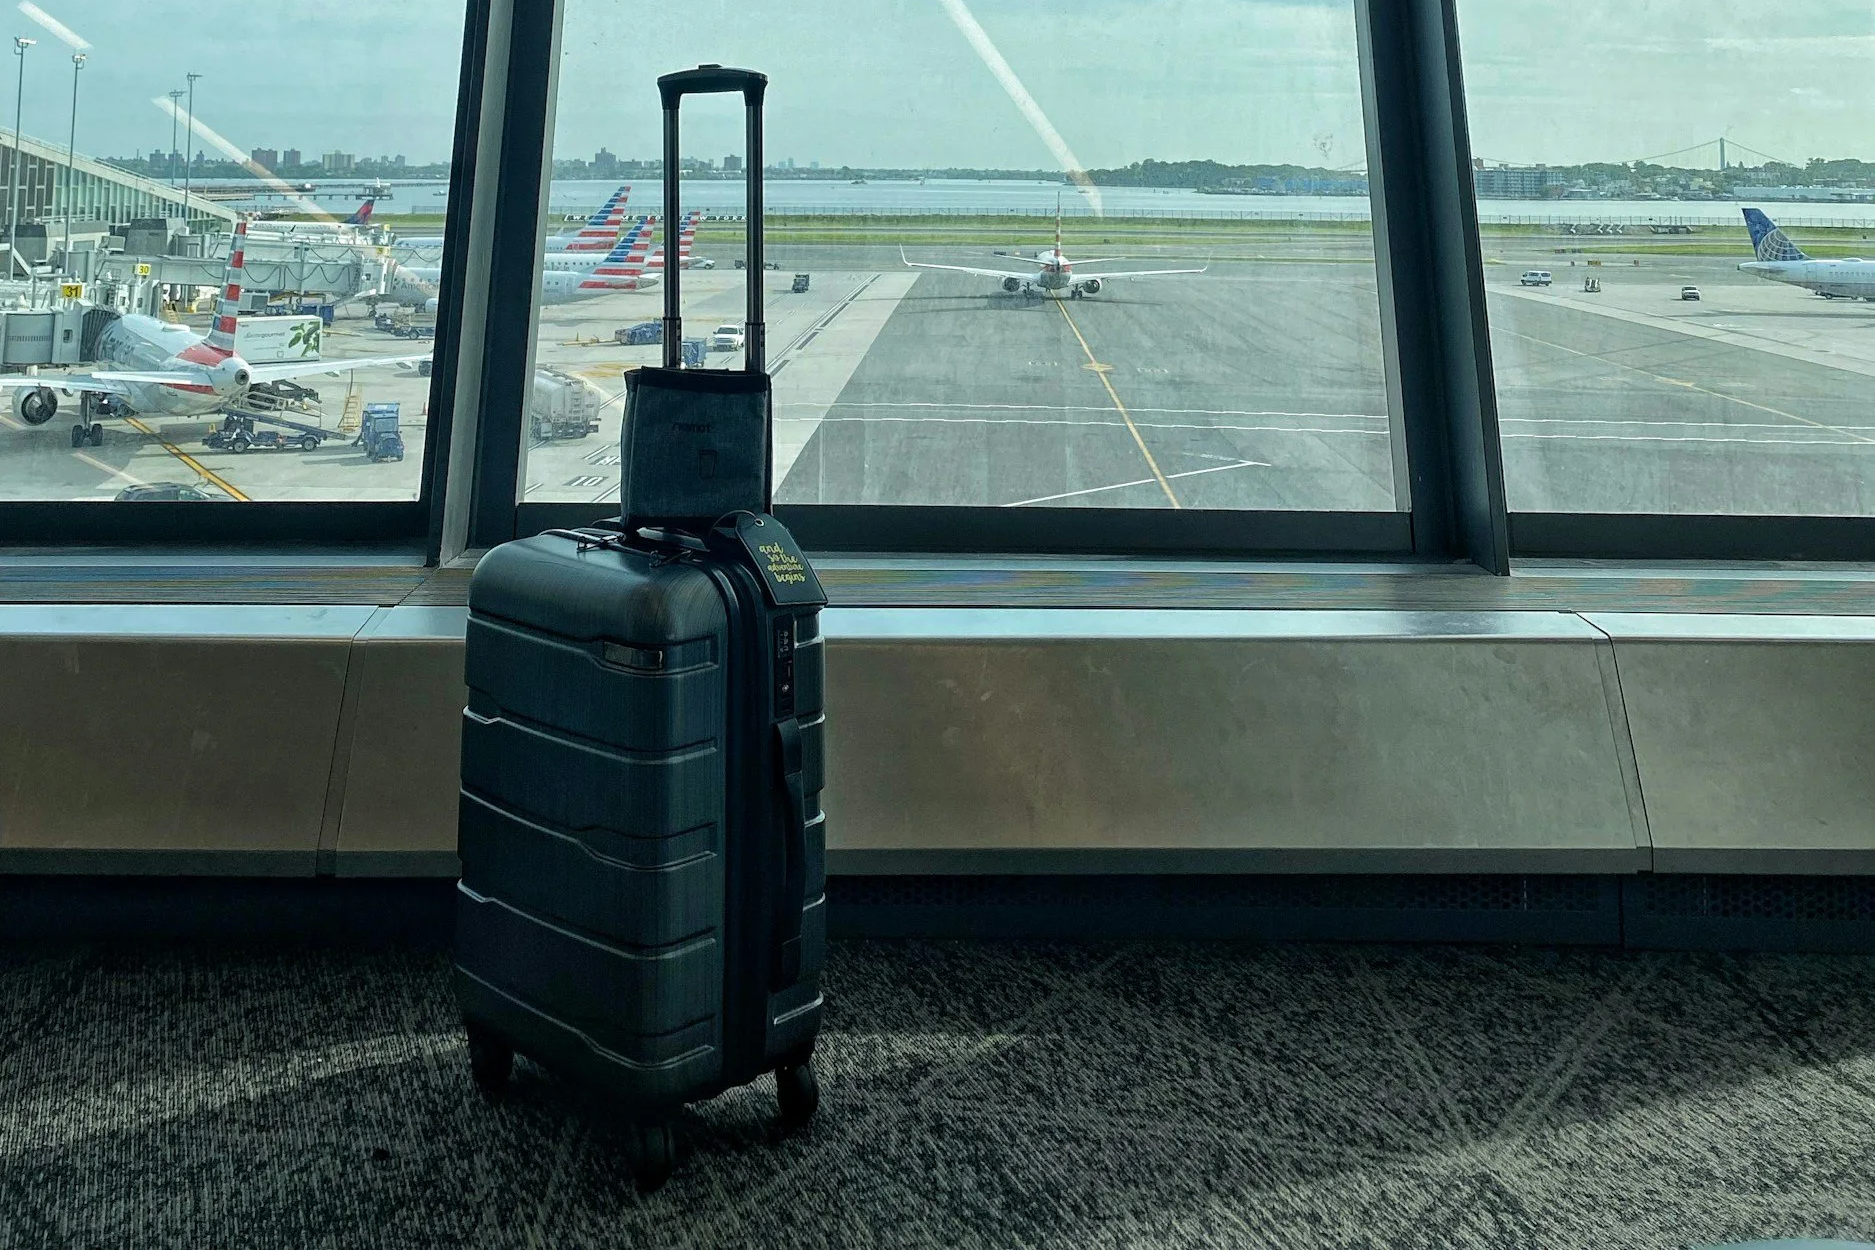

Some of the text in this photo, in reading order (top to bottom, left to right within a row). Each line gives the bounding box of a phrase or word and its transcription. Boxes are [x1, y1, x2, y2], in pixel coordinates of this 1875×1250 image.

[139, 265, 149, 274] 30
[65, 286, 79, 298] 31
[759, 542, 784, 554] and
[767, 553, 798, 564] so the
[767, 562, 804, 572] adventure
[773, 571, 806, 585] begins
